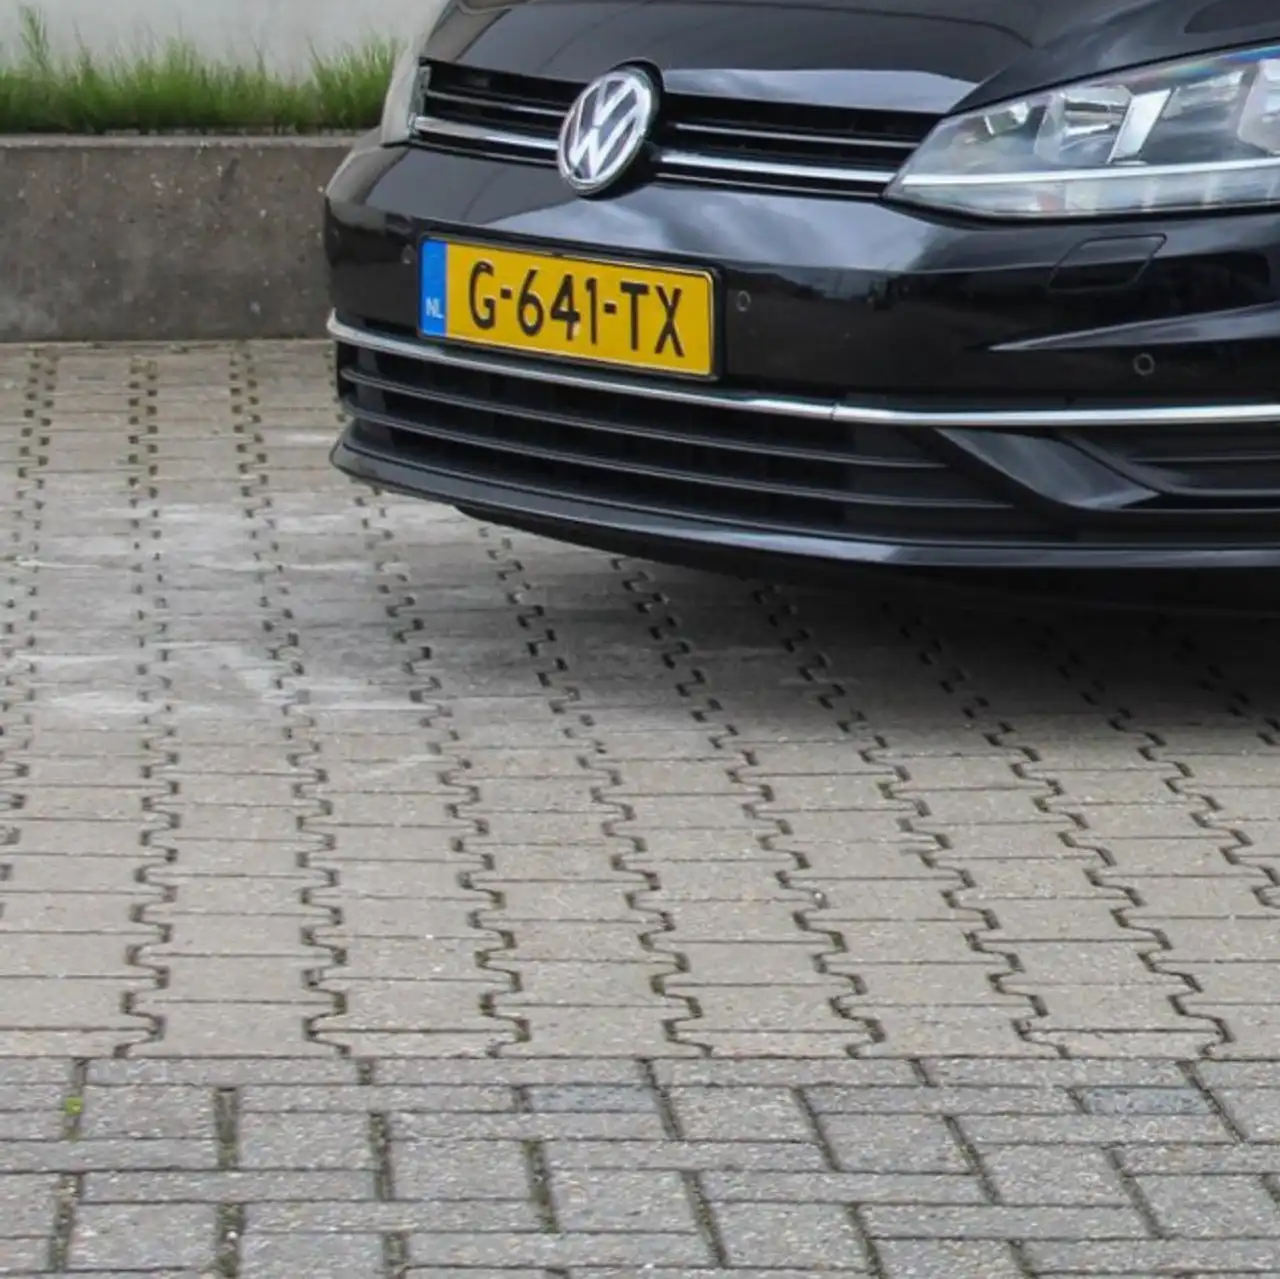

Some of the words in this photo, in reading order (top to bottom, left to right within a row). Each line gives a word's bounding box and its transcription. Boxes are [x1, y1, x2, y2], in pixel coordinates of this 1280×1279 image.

[559, 69, 651, 194] VW
[425, 296, 445, 320] NL
[468, 259, 685, 358] G-641-TX
